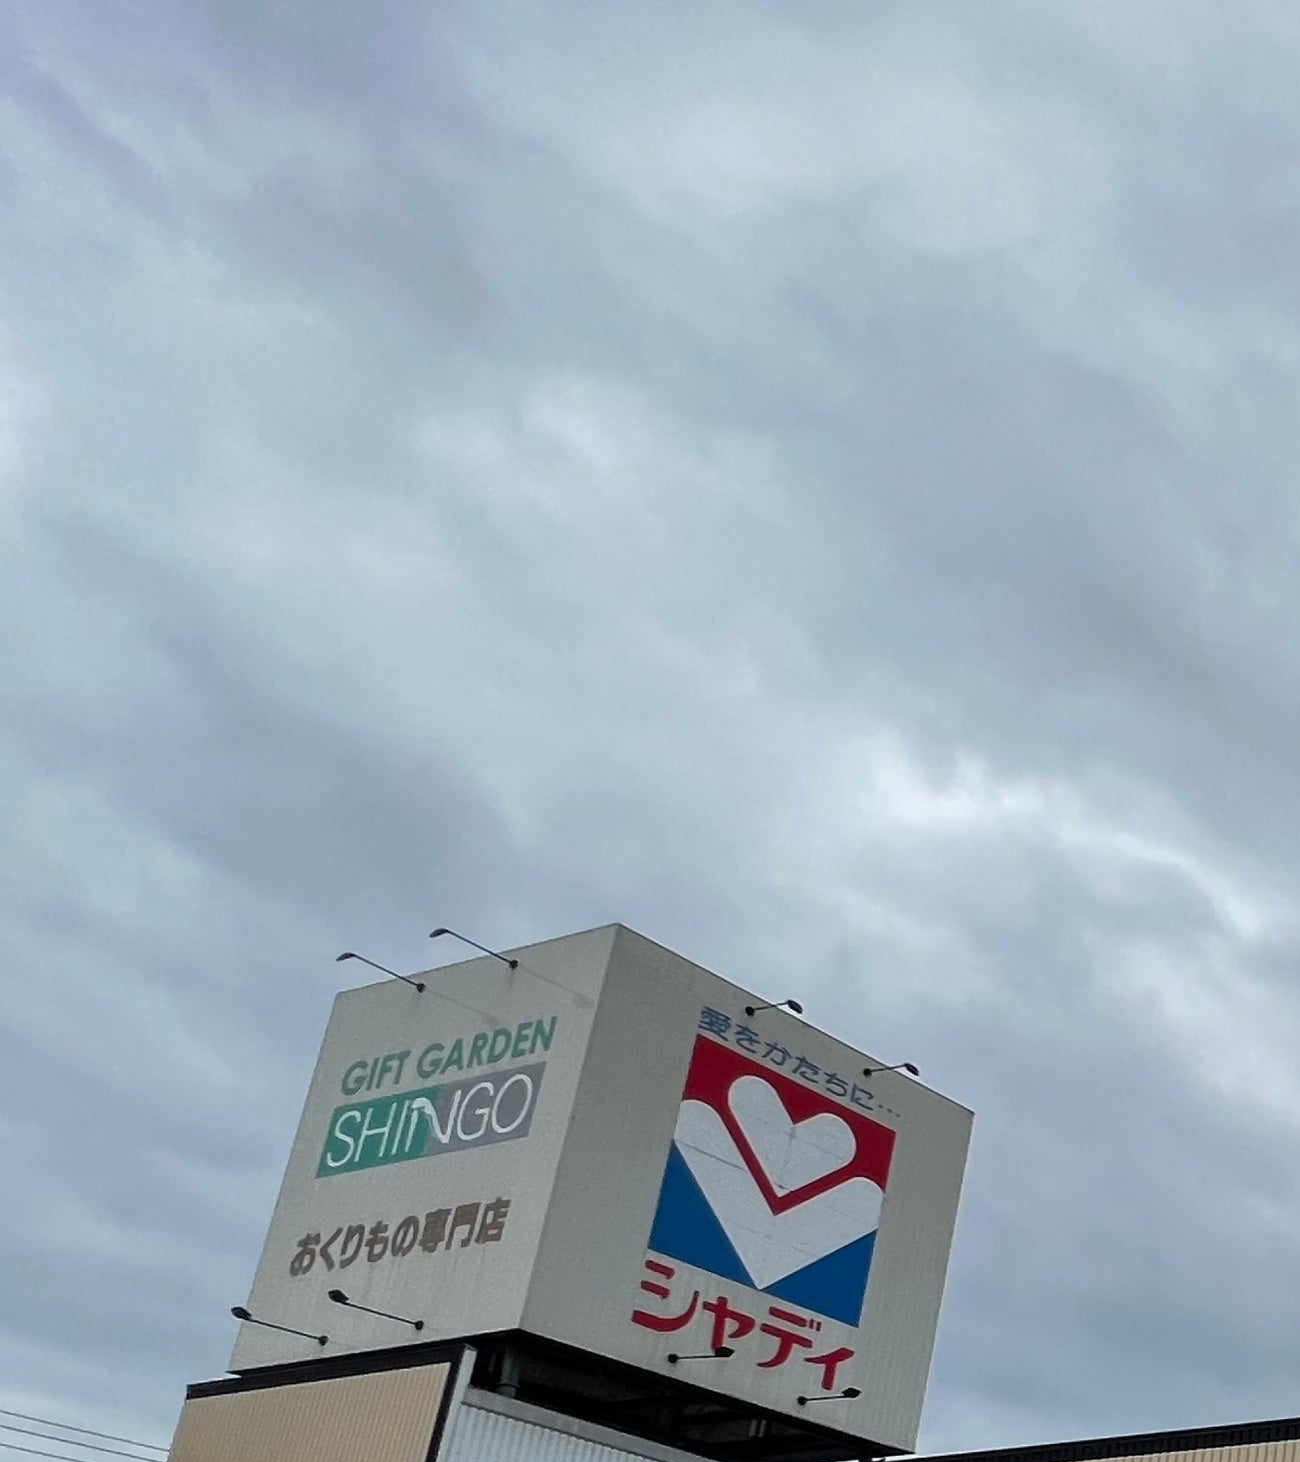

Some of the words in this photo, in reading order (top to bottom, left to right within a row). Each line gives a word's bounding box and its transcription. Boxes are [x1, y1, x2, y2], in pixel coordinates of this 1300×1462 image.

[341, 1051, 409, 1097] GIFT
[416, 1017, 558, 1081] GARDEN
[325, 1072, 533, 1168] SHINGO
[289, 1197, 511, 1277] おくりもの専門店
[631, 1259, 855, 1390] シャディ
